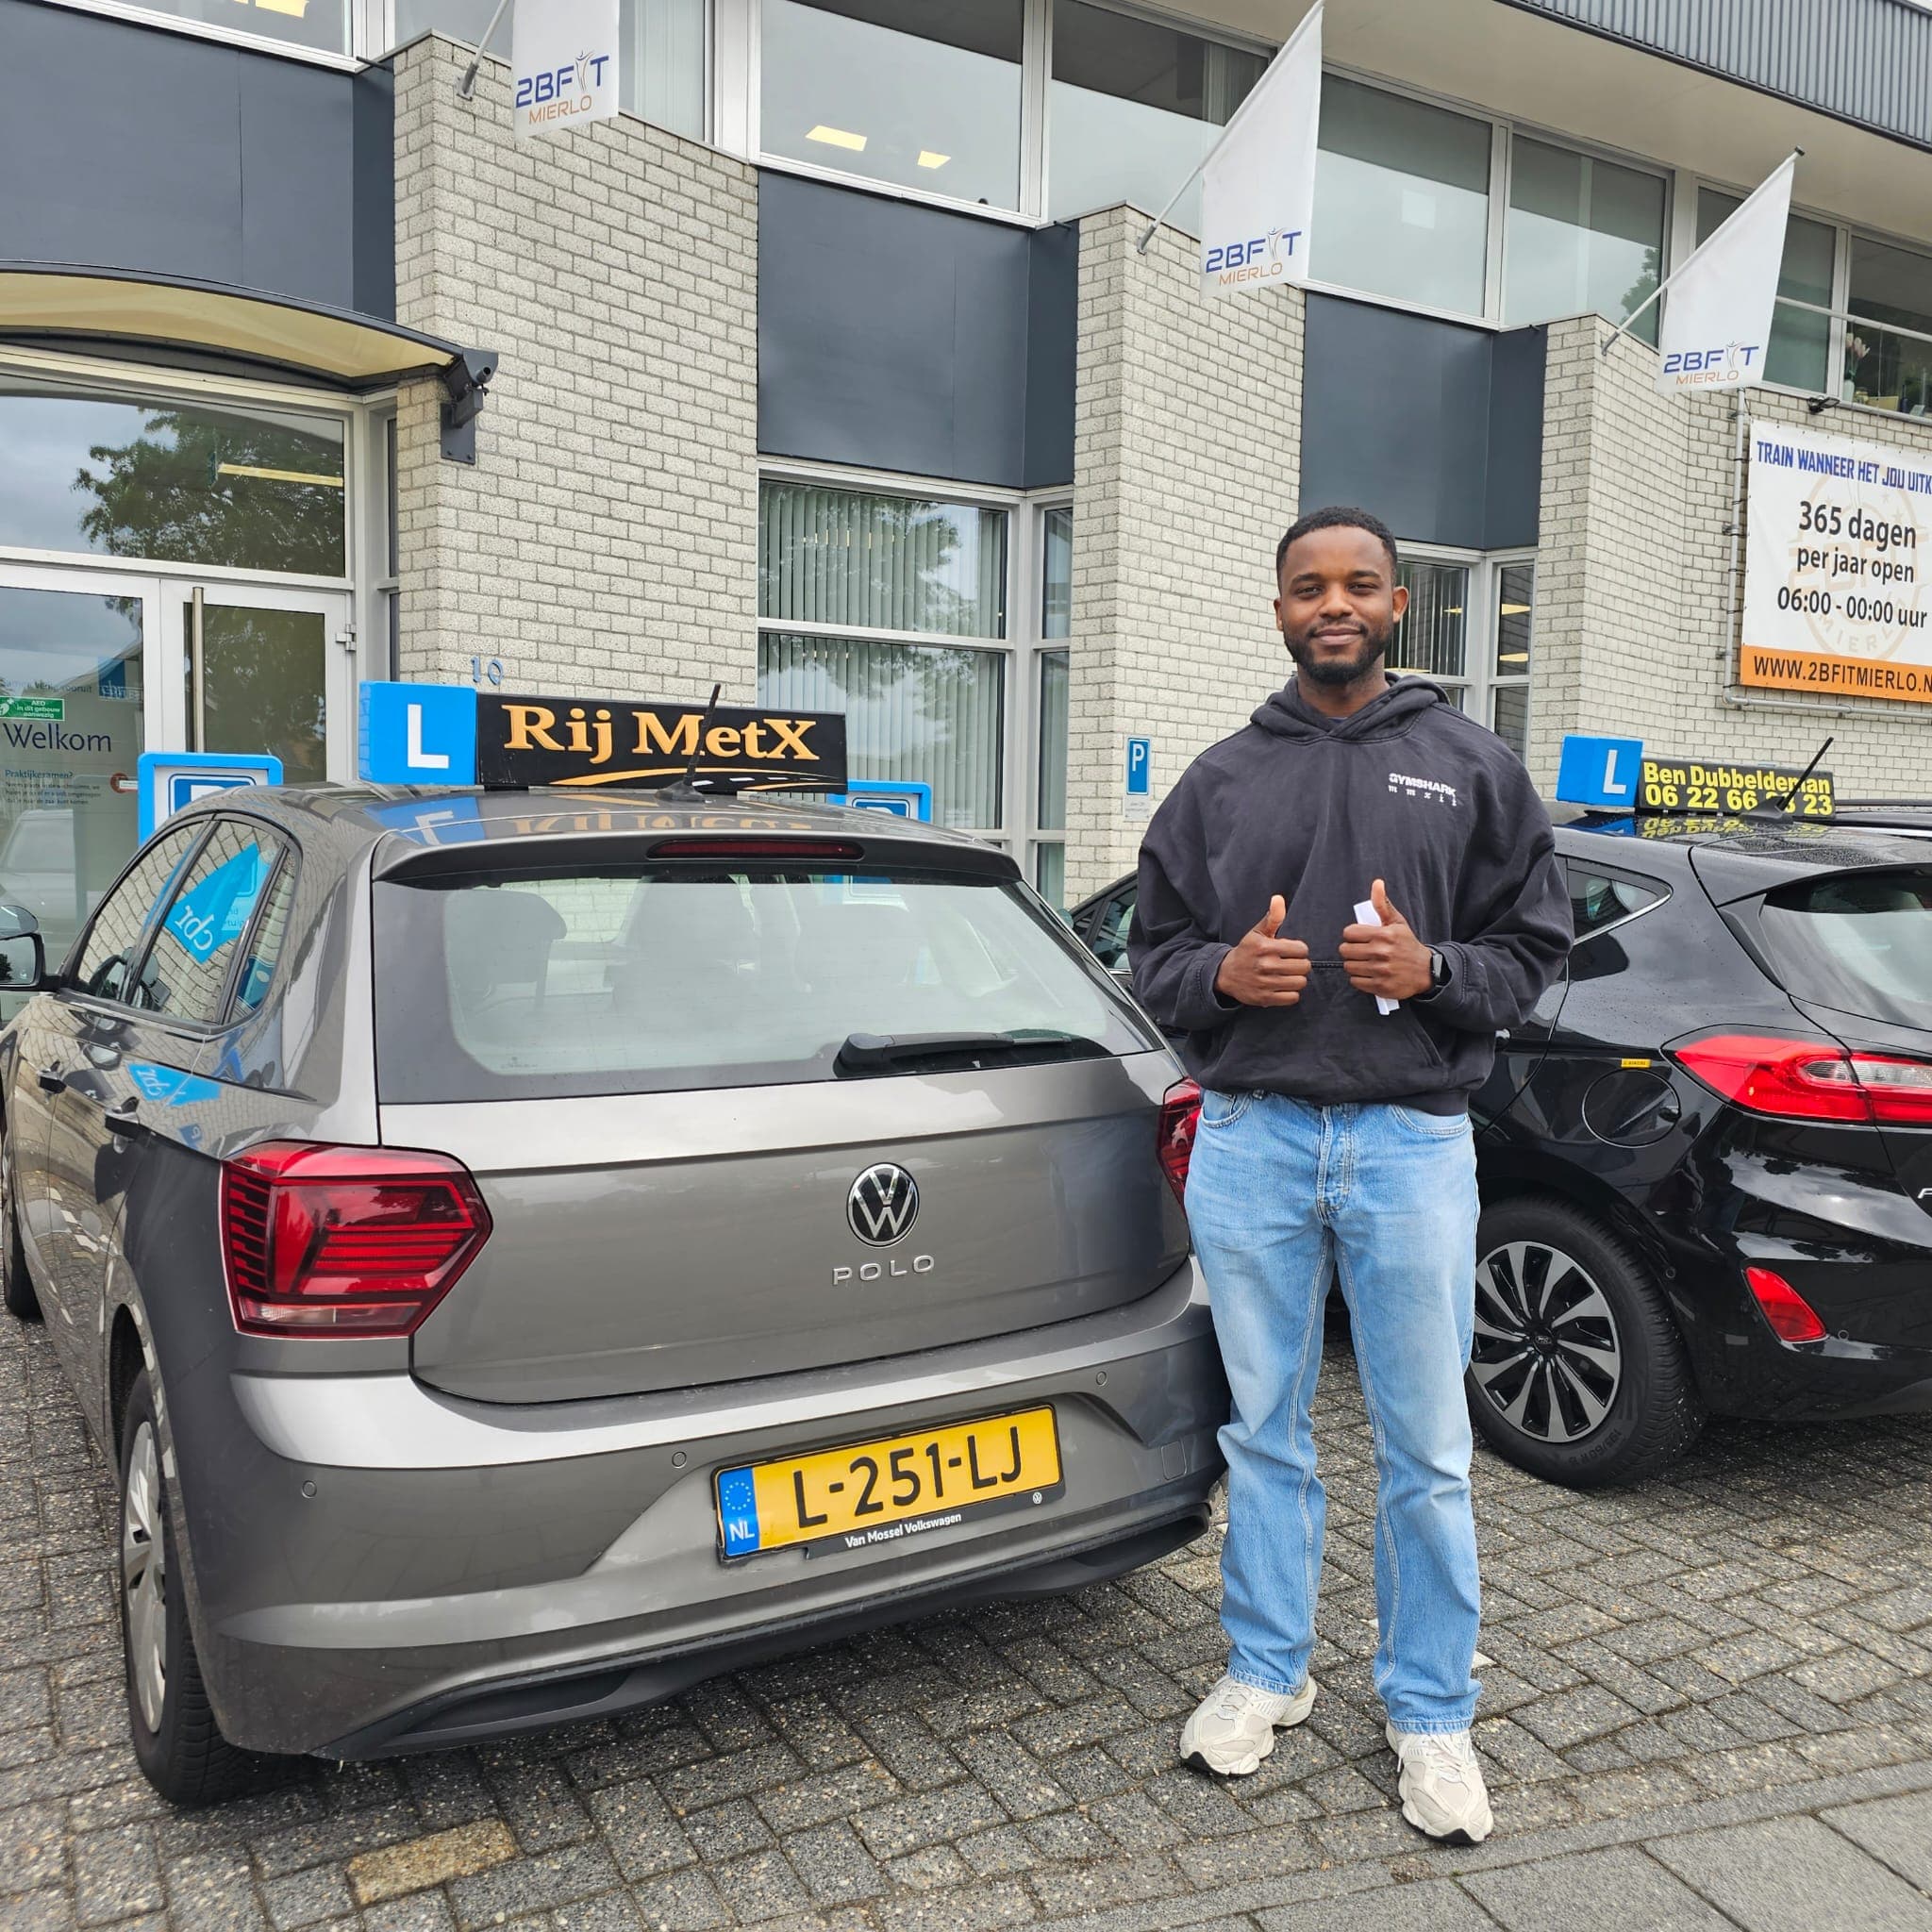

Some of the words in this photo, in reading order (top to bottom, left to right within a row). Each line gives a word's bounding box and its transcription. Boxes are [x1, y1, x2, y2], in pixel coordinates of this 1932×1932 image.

[528, 95, 592, 125] MIERLO
[1219, 262, 1283, 286] MIERLO
[1675, 370, 1740, 385] MIERLO
[1757, 441, 1793, 468] TRAIN
[1797, 448, 1855, 479] WANNEER
[1858, 460, 1880, 484] HET
[1882, 466, 1905, 489] JOU
[1798, 500, 1841, 536] 365
[1848, 508, 1916, 552] dagen
[1797, 546, 1829, 573] per
[1832, 546, 1867, 577] jaar
[1871, 559, 1914, 586] open
[1777, 586, 1831, 615] 06:00
[1846, 595, 1893, 624] 00:00
[1898, 608, 1927, 629] uur
[471, 657, 504, 685] 10
[3, 723, 111, 753] Welkom
[407, 704, 449, 769] L
[501, 703, 614, 765] Rij
[632, 711, 820, 760] MetX
[1132, 743, 1145, 772] P
[1603, 749, 1626, 794] L
[1643, 761, 1686, 785] Ben
[1389, 773, 1457, 796] GYMSHARK
[1645, 784, 1678, 807] 06
[1687, 786, 1719, 808] 22
[1726, 789, 1757, 810] 66
[1803, 794, 1832, 815] 23
[833, 1255, 935, 1285] POLO
[729, 1518, 756, 1542] NL
[793, 1425, 1022, 1528] L-251-LJ
[845, 1536, 866, 1548] Van
[867, 1524, 903, 1542] Mossel
[904, 1513, 962, 1534] Volkswagen
